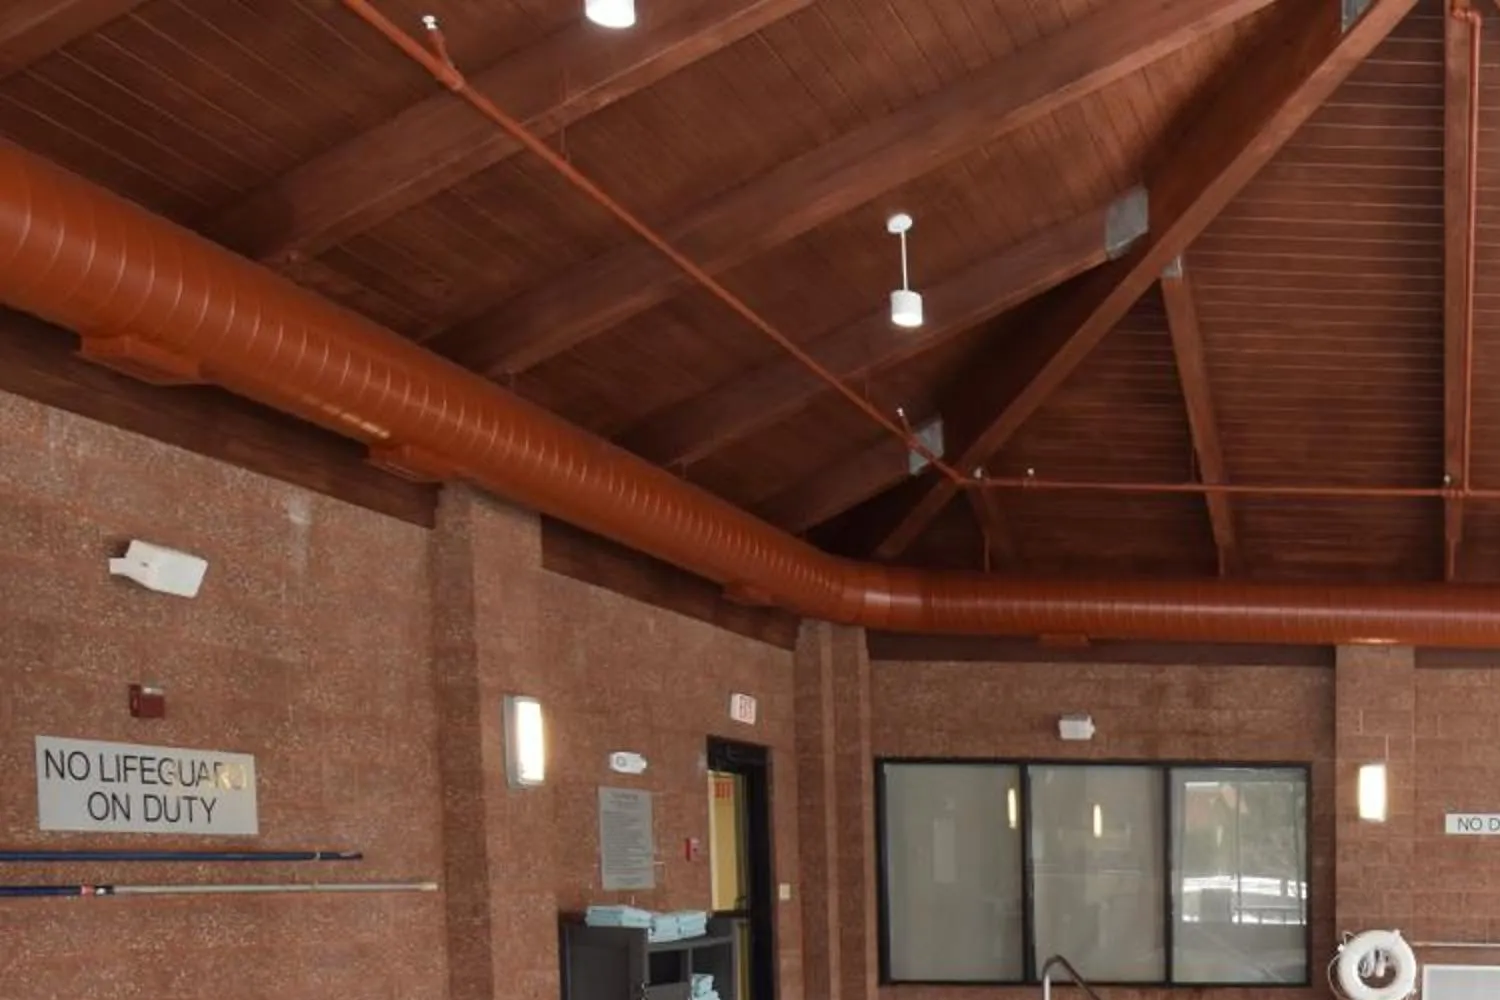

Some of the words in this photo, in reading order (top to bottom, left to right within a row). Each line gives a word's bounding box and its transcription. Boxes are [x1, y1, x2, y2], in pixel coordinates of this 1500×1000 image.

[44, 748, 91, 781] NO
[87, 791, 132, 822] ON
[143, 793, 217, 824] DUTY
[1457, 817, 1483, 832] NO
